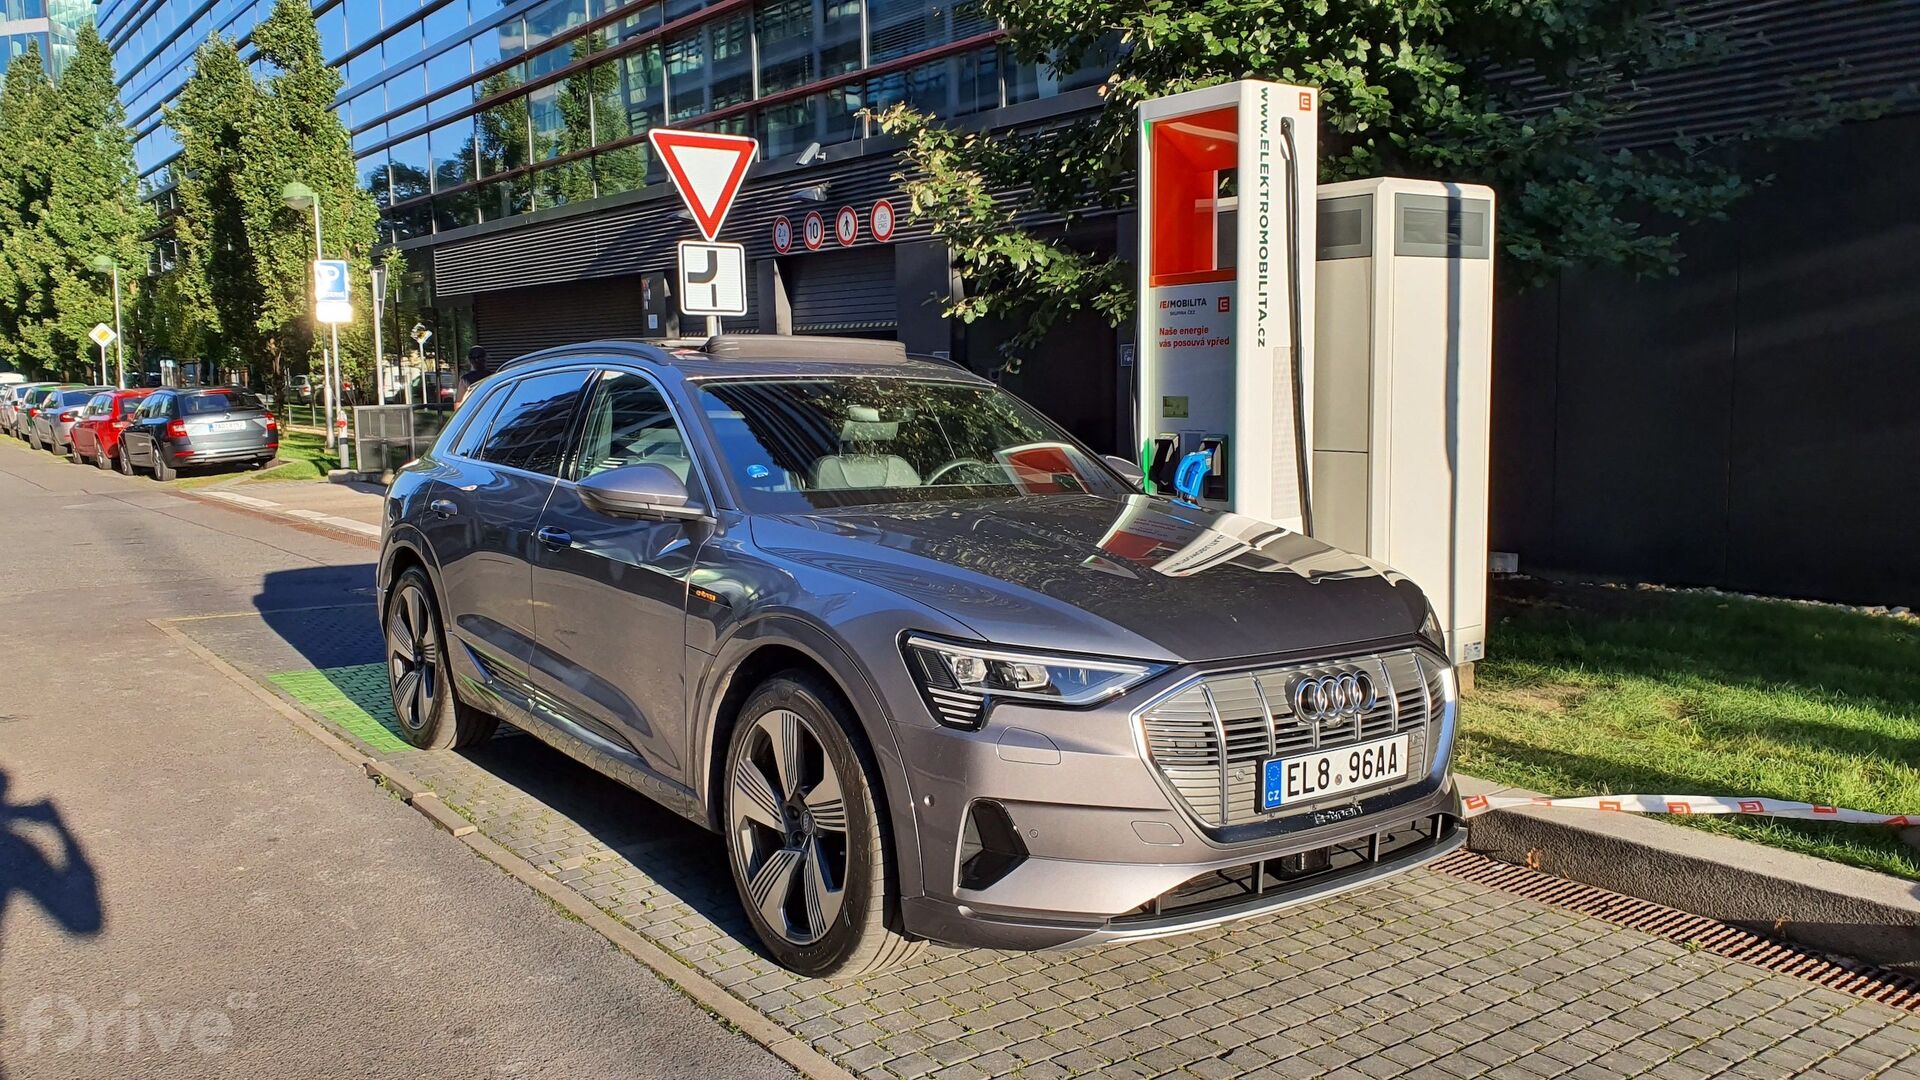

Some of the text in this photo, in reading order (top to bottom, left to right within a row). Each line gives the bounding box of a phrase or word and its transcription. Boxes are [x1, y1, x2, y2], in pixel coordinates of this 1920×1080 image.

[808, 222, 819, 240] 10
[1159, 325, 1209, 336] Naše energie
[1159, 336, 1230, 348] vás posouvá vpřed
[1287, 742, 1397, 797] EL8 96AA
[1267, 790, 1279, 801] CZ
